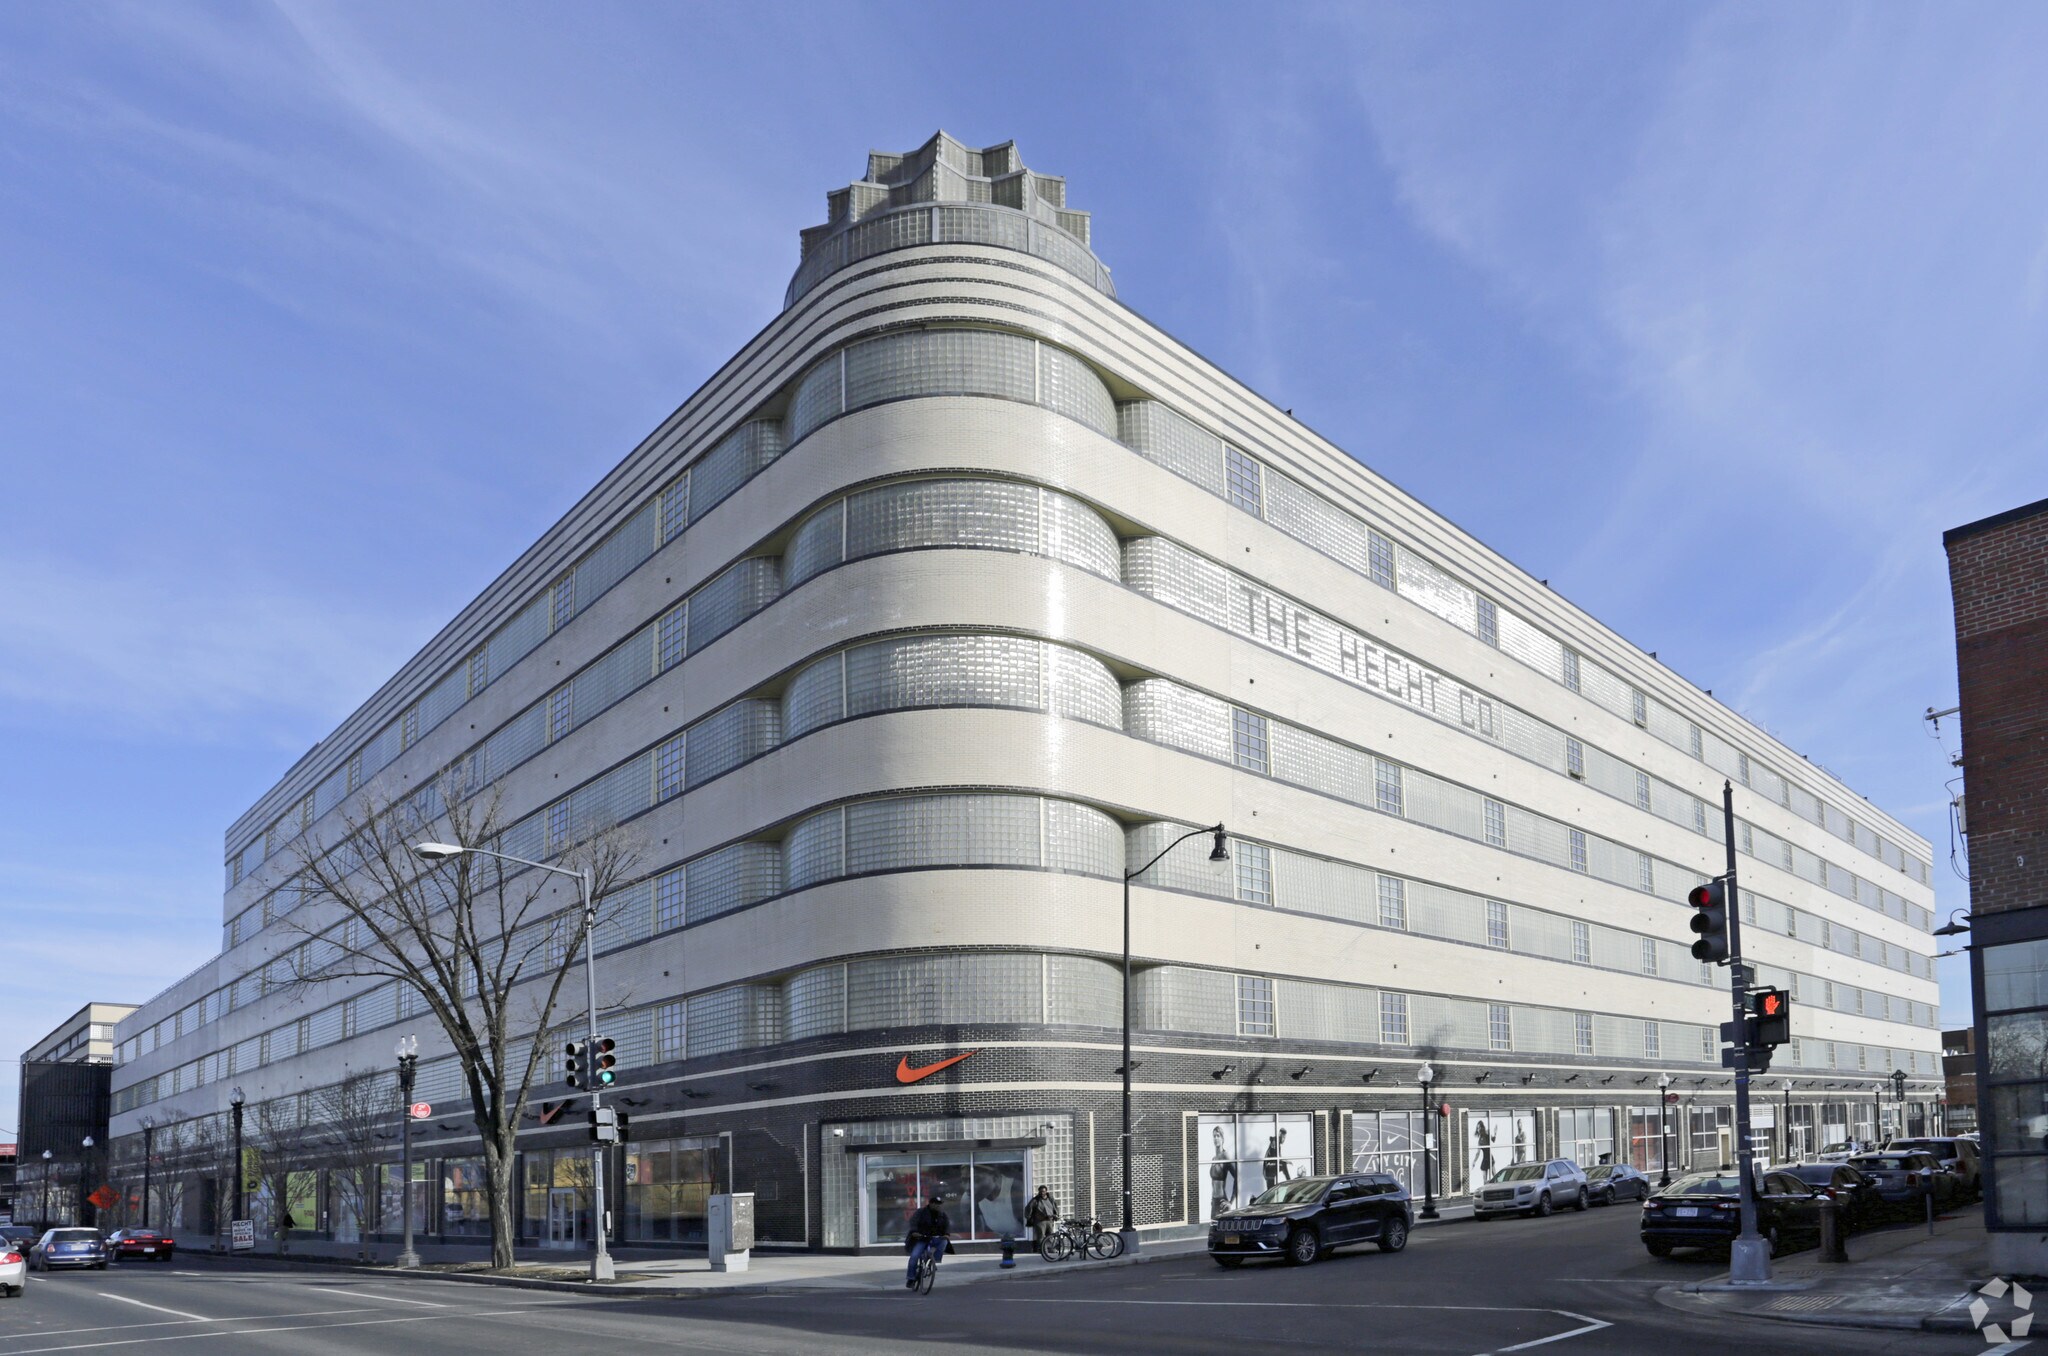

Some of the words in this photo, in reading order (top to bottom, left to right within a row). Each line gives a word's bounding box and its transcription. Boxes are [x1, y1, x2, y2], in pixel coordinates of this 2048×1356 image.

[1240, 584, 1311, 659] THE
[1340, 631, 1439, 713] HECHT
[1394, 1154, 1416, 1169] CITY
[233, 1235, 253, 1243] SALE
